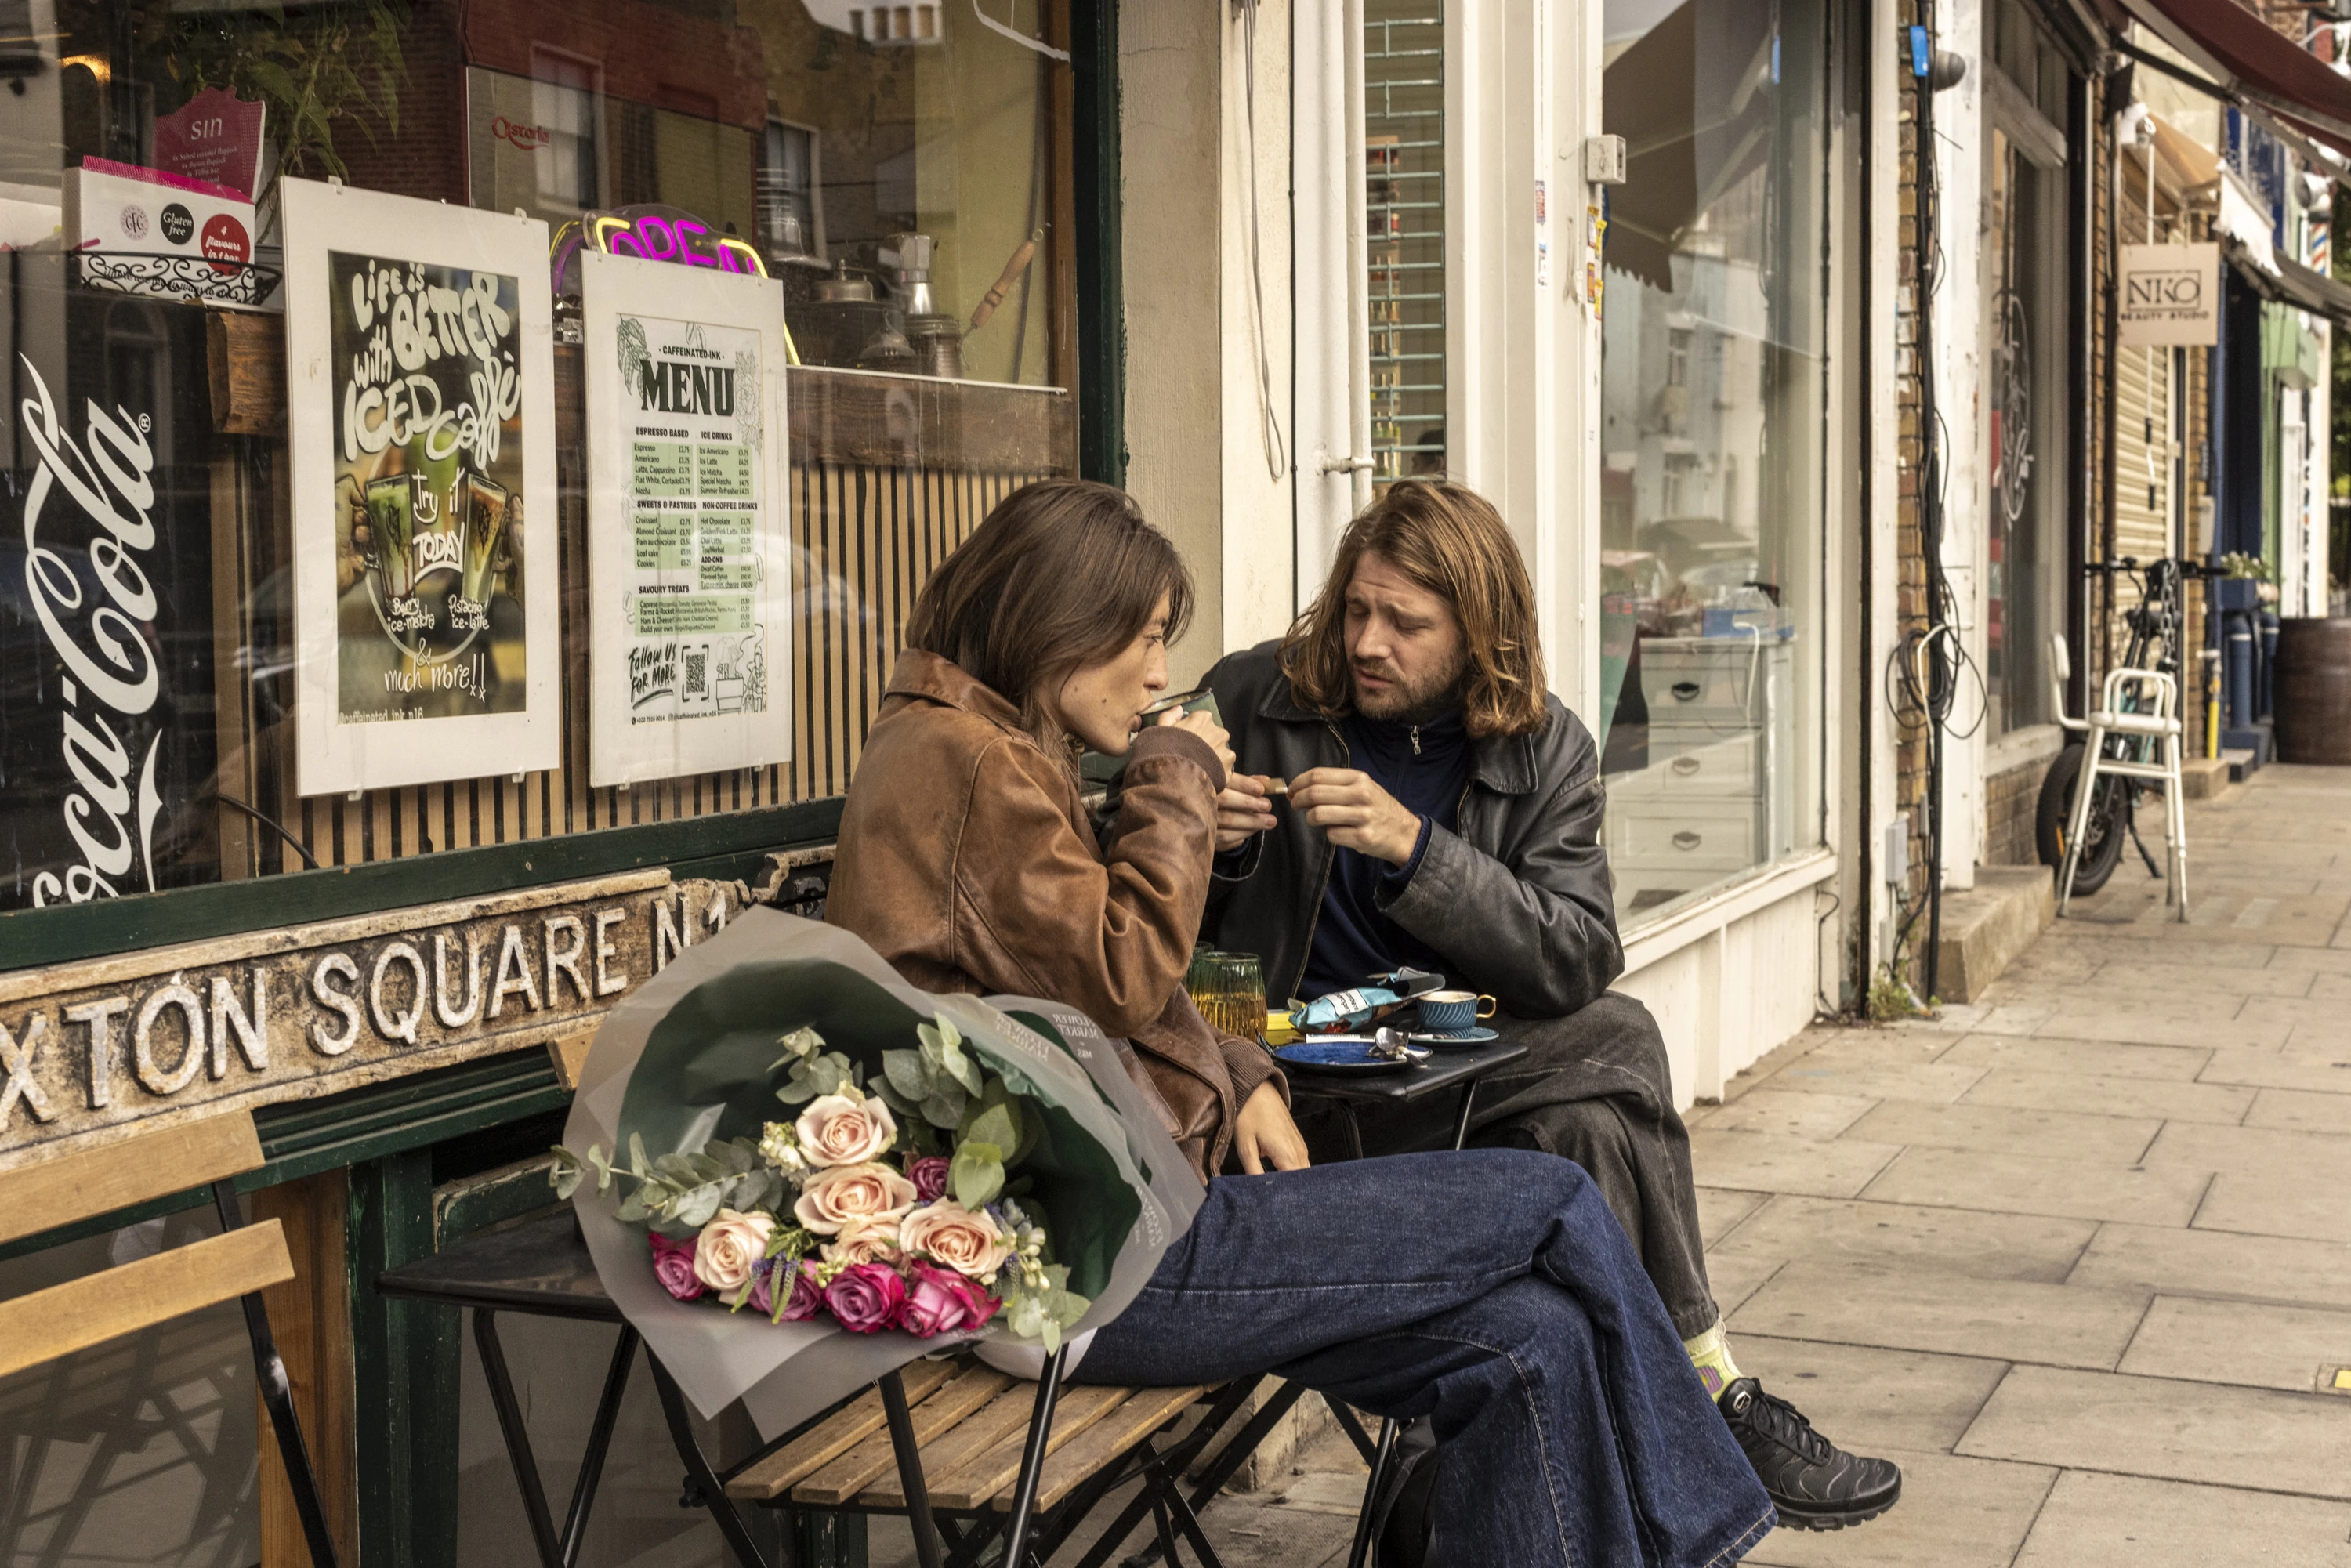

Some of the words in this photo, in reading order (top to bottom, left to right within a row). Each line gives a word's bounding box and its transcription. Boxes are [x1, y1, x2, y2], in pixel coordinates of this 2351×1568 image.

[191, 118, 223, 141] sin
[125, 212, 144, 234] GFG
[163, 212, 193, 227] Gluten
[168, 226, 186, 236] free
[221, 226, 227, 236] 4
[205, 236, 241, 251] flavours
[639, 359, 735, 416] MENU
[344, 374, 442, 462] ICED
[636, 426, 668, 436] ESPRESSO
[669, 429, 689, 438] BASED
[712, 432, 732, 440] DRINKS
[634, 443, 656, 452] Espresso
[707, 447, 729, 455] Americano
[635, 454, 660, 463] Americano
[650, 465, 676, 475] Cappuccino
[700, 477, 715, 486] Special
[636, 487, 651, 495] Mocha
[637, 500, 661, 509] SWEETS
[669, 501, 697, 509] PASTRIES
[636, 516, 658, 524] Croissant
[656, 527, 677, 536] Croissant
[413, 523, 465, 572] TODAY
[637, 559, 656, 568] Cookies
[639, 585, 666, 594] SAVOURY
[668, 585, 690, 593] TREATS
[392, 597, 420, 617] Berry
[448, 594, 483, 614] Pistachio
[640, 600, 657, 609] Caprese
[417, 637, 432, 667] &
[384, 654, 423, 693] much
[630, 672, 649, 703] FOR
[652, 664, 676, 687] MORE
[313, 907, 627, 1056] SQUARE
